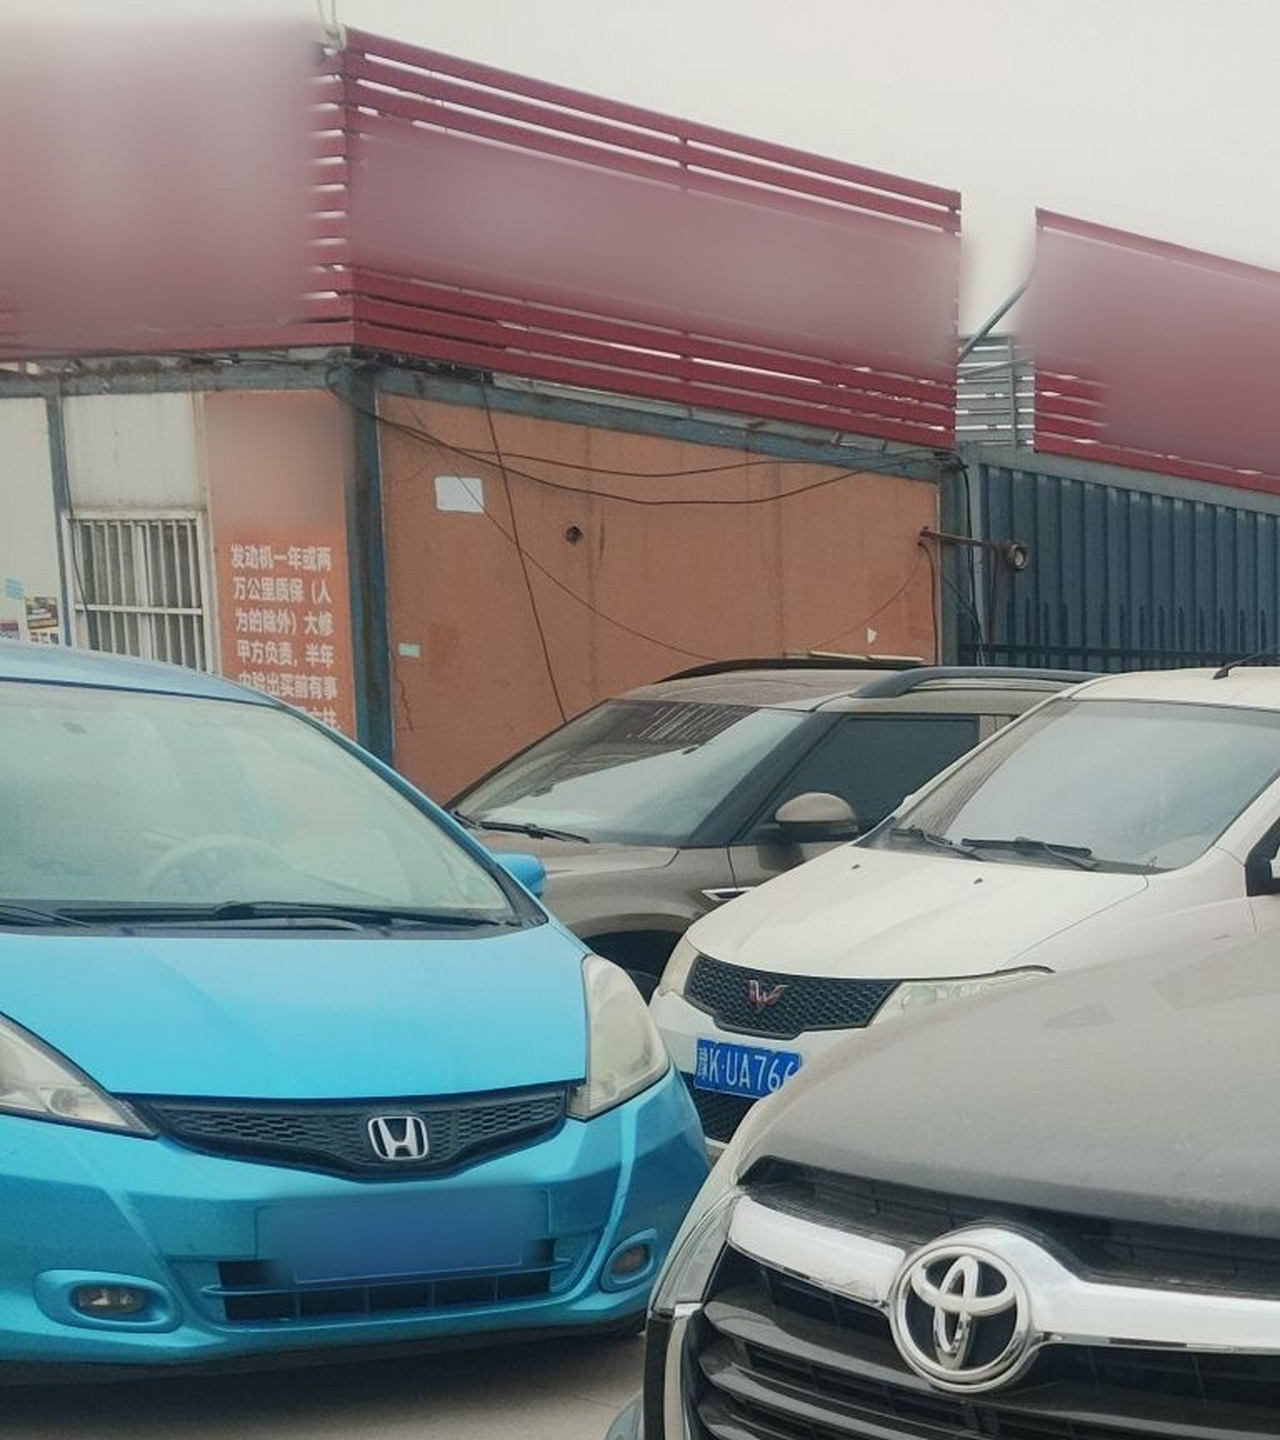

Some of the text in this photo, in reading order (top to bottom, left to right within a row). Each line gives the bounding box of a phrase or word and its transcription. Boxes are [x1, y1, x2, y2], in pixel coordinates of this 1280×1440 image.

[231, 545, 331, 572] 发动机一年或两
